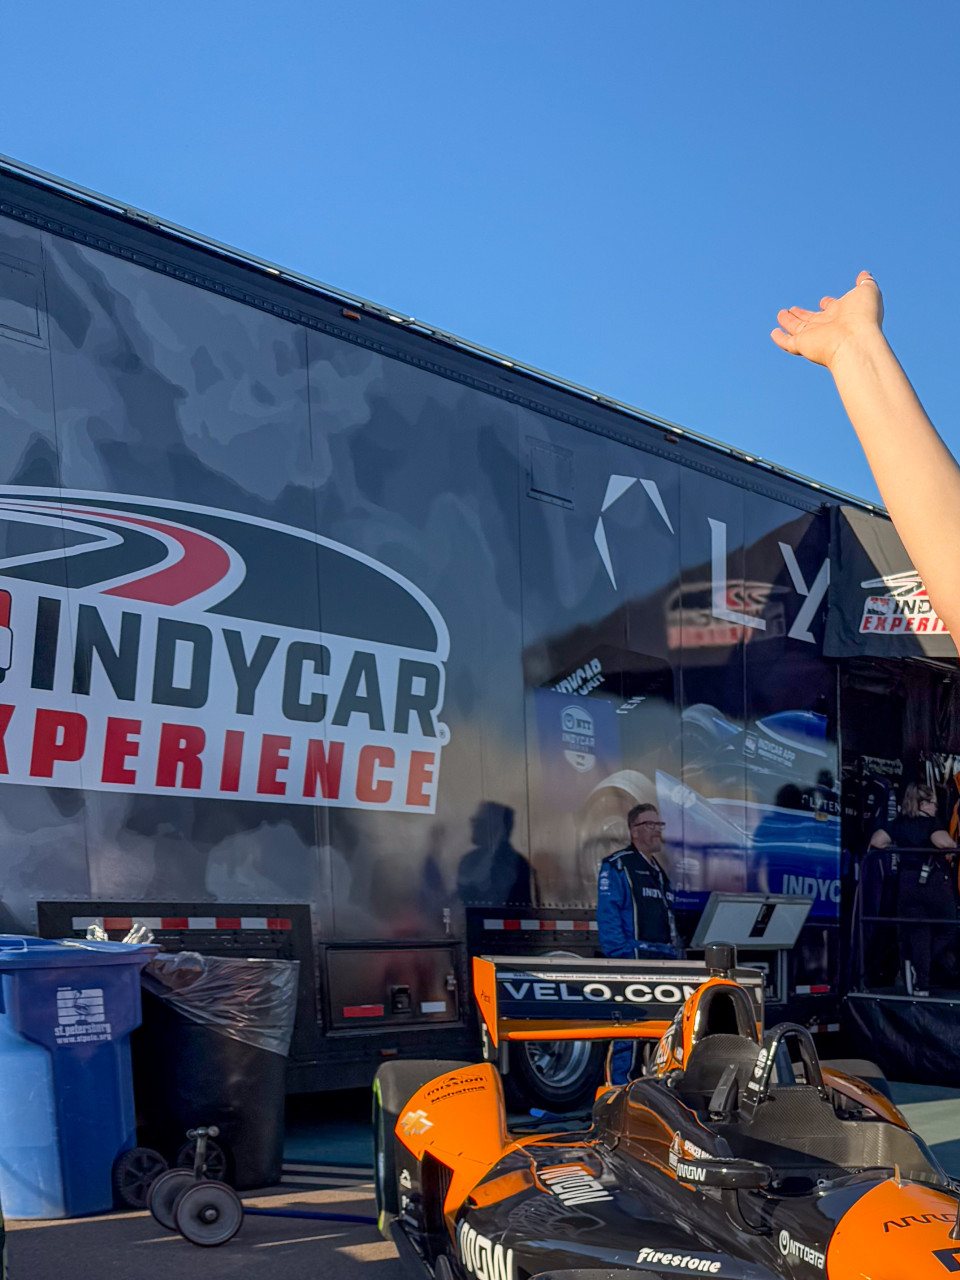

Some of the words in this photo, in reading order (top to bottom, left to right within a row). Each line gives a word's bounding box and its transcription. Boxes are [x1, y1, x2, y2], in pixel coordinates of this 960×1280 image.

[31, 595, 439, 738] INDYCAR
[0, 705, 435, 807] PERIENCE
[636, 1247, 722, 1274] Firestone
